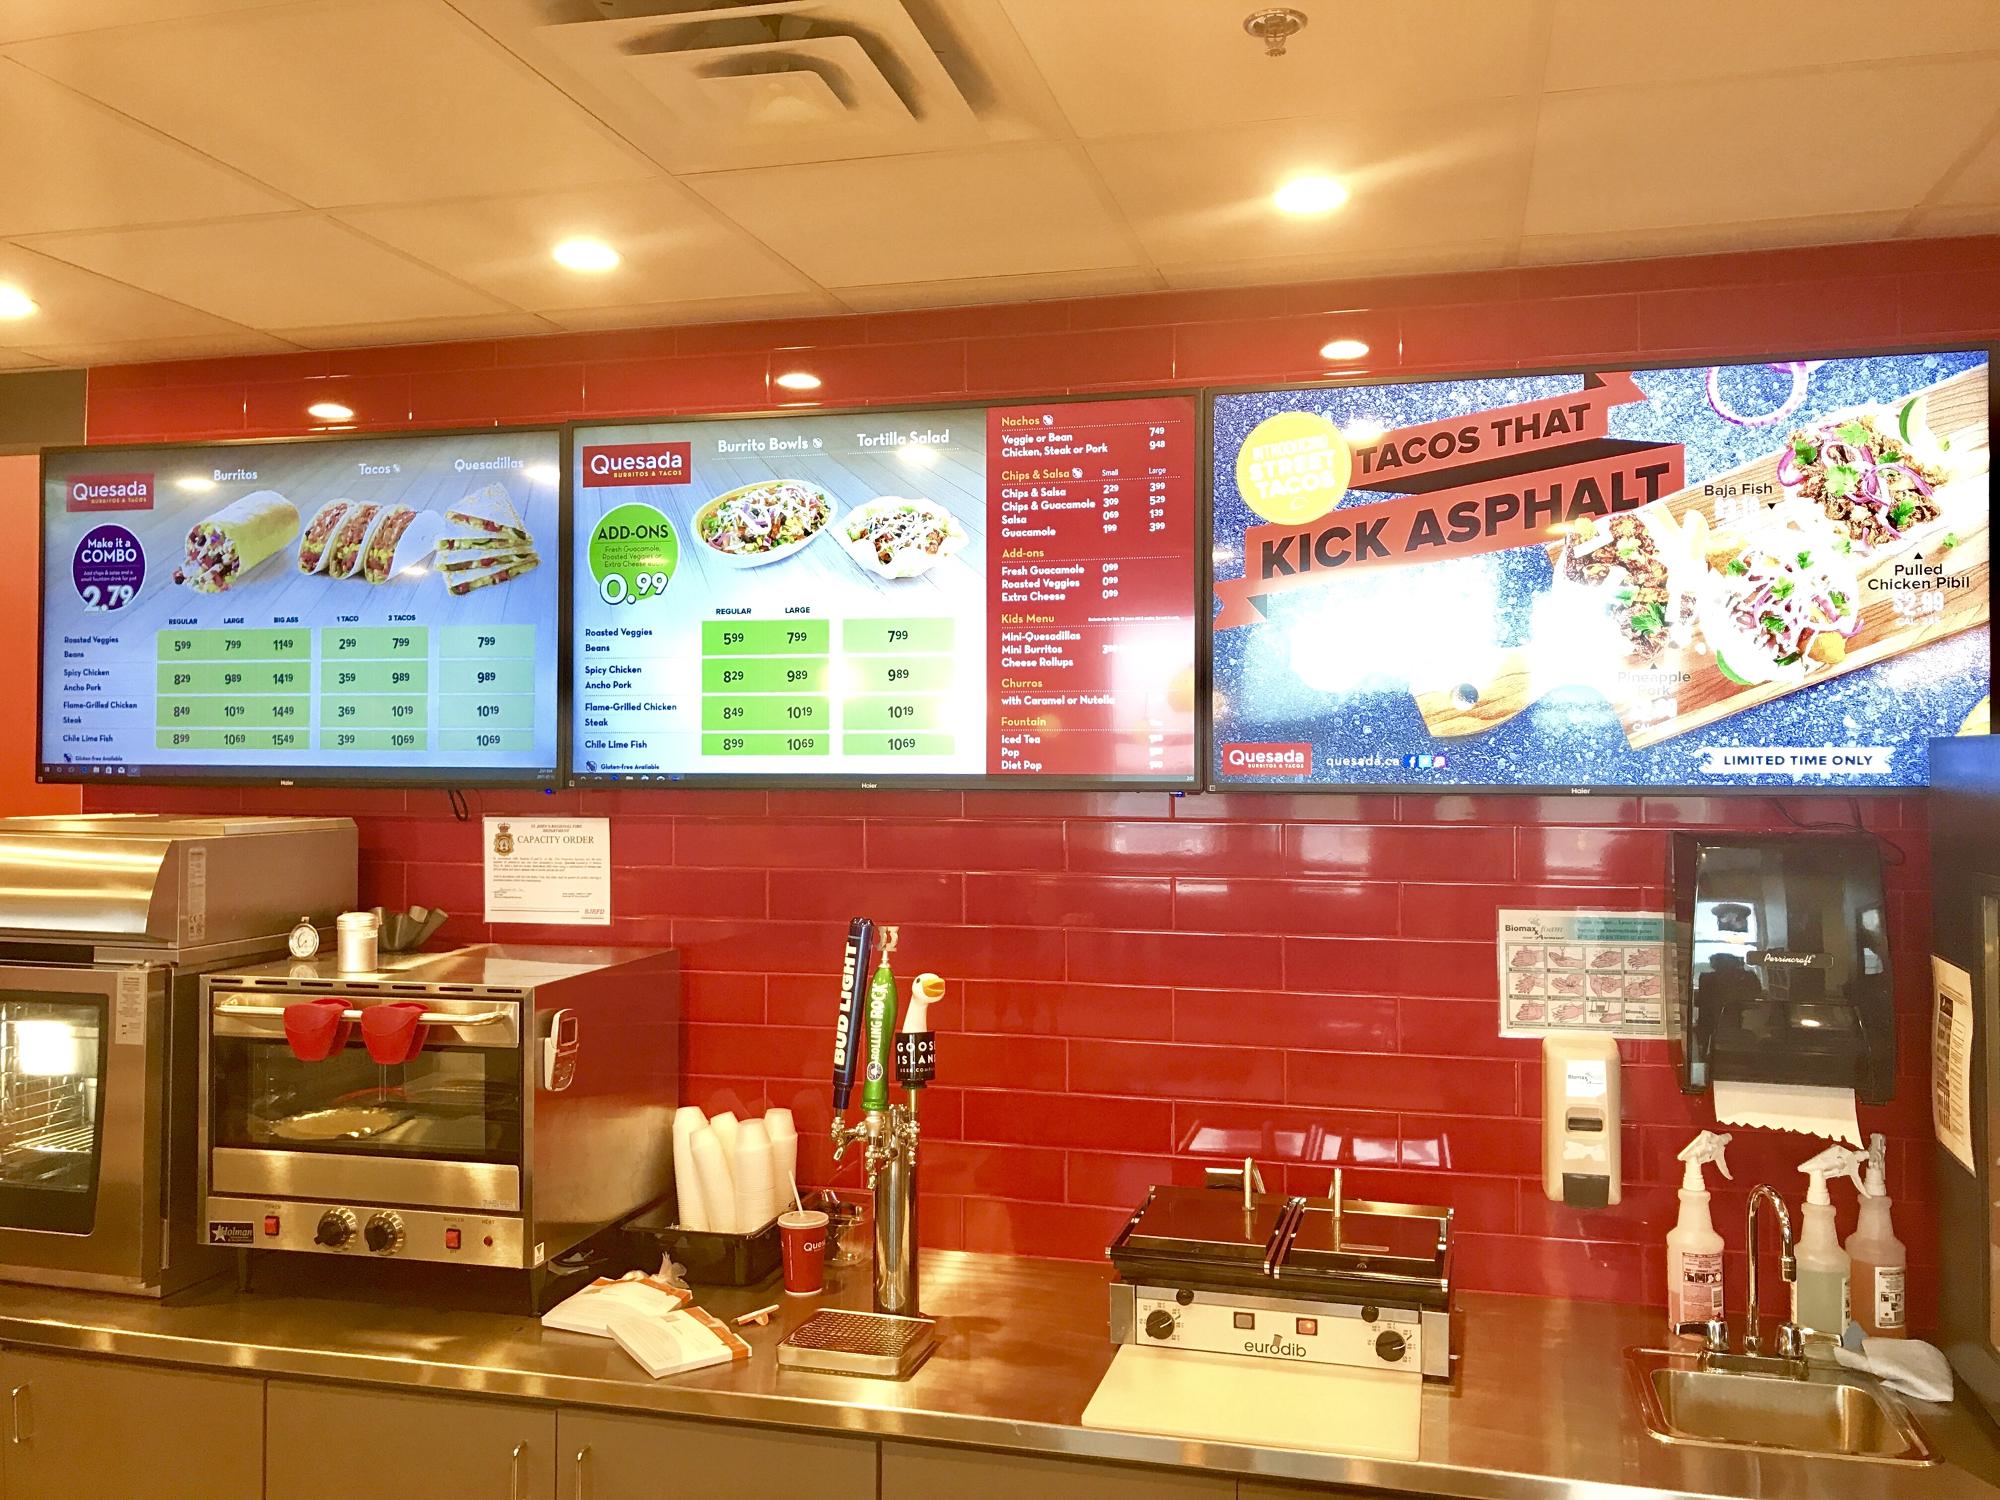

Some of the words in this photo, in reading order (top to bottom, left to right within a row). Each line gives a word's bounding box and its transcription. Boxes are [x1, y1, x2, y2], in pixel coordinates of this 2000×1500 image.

[1002, 416, 1040, 427] Nachos
[718, 439, 765, 452] Burrito
[770, 436, 808, 450] Bowls
[857, 432, 906, 447] Tortilla
[910, 429, 950, 444] Salad
[1002, 434, 1034, 446] Veggie
[1048, 433, 1072, 442] Bean
[1356, 425, 1481, 474] TACOS
[1490, 403, 1591, 442] THAT
[1002, 447, 1042, 458] Chicken,
[1044, 445, 1071, 455] Steak
[1073, 446, 1084, 454] or
[1085, 443, 1108, 454] Pork
[359, 463, 391, 475] Tacos
[454, 456, 524, 473] Quesadillas
[591, 452, 682, 474] Quesada
[214, 469, 258, 481] Burritos
[1002, 471, 1029, 482] Chips
[1032, 470, 1040, 480] &
[1043, 468, 1070, 478] Salsa
[1102, 469, 1118, 477] Small
[1148, 467, 1166, 476] Large
[73, 481, 147, 500] Quesada
[1256, 470, 1335, 500] TACOS
[1704, 484, 1736, 498] Baja
[1742, 483, 1772, 494] Fish
[1002, 489, 1028, 500] Chips
[1031, 488, 1039, 497] &
[1041, 487, 1066, 497] Salsa
[1002, 502, 1028, 513] Chips
[1031, 502, 1038, 511] &
[1041, 498, 1096, 510] Guacamole
[1002, 515, 1027, 525] Salsa
[1262, 516, 1391, 579] KICK
[1404, 462, 1670, 553] ASPHALT
[598, 525, 668, 540] ADD-ONS
[1002, 526, 1056, 538] Guacamole
[88, 538, 113, 549] Make
[115, 539, 124, 548] it
[81, 550, 137, 563] COMBO
[1002, 548, 1044, 558] Add-ons
[1002, 566, 1027, 576] Fresh
[1030, 564, 1085, 575] Guacamole
[1895, 564, 1942, 576] Pulled
[600, 572, 668, 605] 0.99
[1002, 578, 1040, 589] Roasted
[1043, 578, 1080, 590] Veggies
[1868, 578, 1930, 590] Chicken
[1936, 577, 1969, 588] Pibil
[82, 584, 134, 613] 2.79
[1002, 593, 1027, 602] Extra
[1030, 591, 1066, 601] Cheese
[273, 616, 286, 624] BIG
[1002, 614, 1023, 624] Kids
[1026, 613, 1055, 623] Menu
[621, 628, 652, 637] Veggies
[1002, 631, 1081, 642] Mini-Quesadillas
[64, 636, 91, 644] Roasted
[94, 636, 119, 646] Veggies
[585, 644, 610, 652] Beans
[1002, 645, 1022, 654] Mini
[1024, 644, 1062, 654] Burritos
[1002, 658, 1037, 667] Cheese
[1039, 657, 1074, 669] Rollups
[64, 668, 81, 678] Spicy
[84, 668, 110, 676] Chicken
[585, 666, 607, 675] Spicy
[609, 666, 642, 674] Chicken
[64, 684, 84, 692] Ancho
[585, 681, 611, 689] Ancho
[613, 681, 632, 689] Pork
[1002, 678, 1042, 688] Churros
[63, 701, 109, 709] Flame-Grilled
[110, 701, 138, 709] Chicken
[1001, 696, 1021, 705] with
[1024, 696, 1065, 705] Caramel
[1067, 697, 1078, 705] or
[1080, 695, 1115, 704] Nutella
[585, 703, 641, 711] Flame-Grilled
[643, 703, 677, 711] Chicken
[63, 716, 81, 724] Steak
[1001, 717, 1046, 727] Fountain
[63, 734, 80, 742] Chile
[81, 734, 99, 742] Lime
[101, 734, 113, 742] Fish
[1002, 734, 1021, 744] Iced
[1024, 735, 1040, 744] Tea
[585, 741, 606, 749] Chile
[631, 740, 647, 748] Fish
[1002, 748, 1019, 759] Pop
[1229, 749, 1304, 766] Quesada
[1002, 760, 1021, 770] Diet
[1024, 761, 1042, 771] Pop
[1326, 755, 1399, 768] quesada.ca
[1724, 755, 1785, 766] LIMITED
[1790, 755, 1827, 765] TIME
[1832, 755, 1873, 765] ONLY
[517, 836, 560, 844] CAPACITY
[562, 836, 594, 844] ORDER
[840, 942, 857, 1011] LIGHT
[870, 982, 888, 1019] ROCK
[834, 1014, 850, 1066] BUD
[870, 1020, 882, 1064] ROLLING
[1244, 1339, 1306, 1357] eurodib
